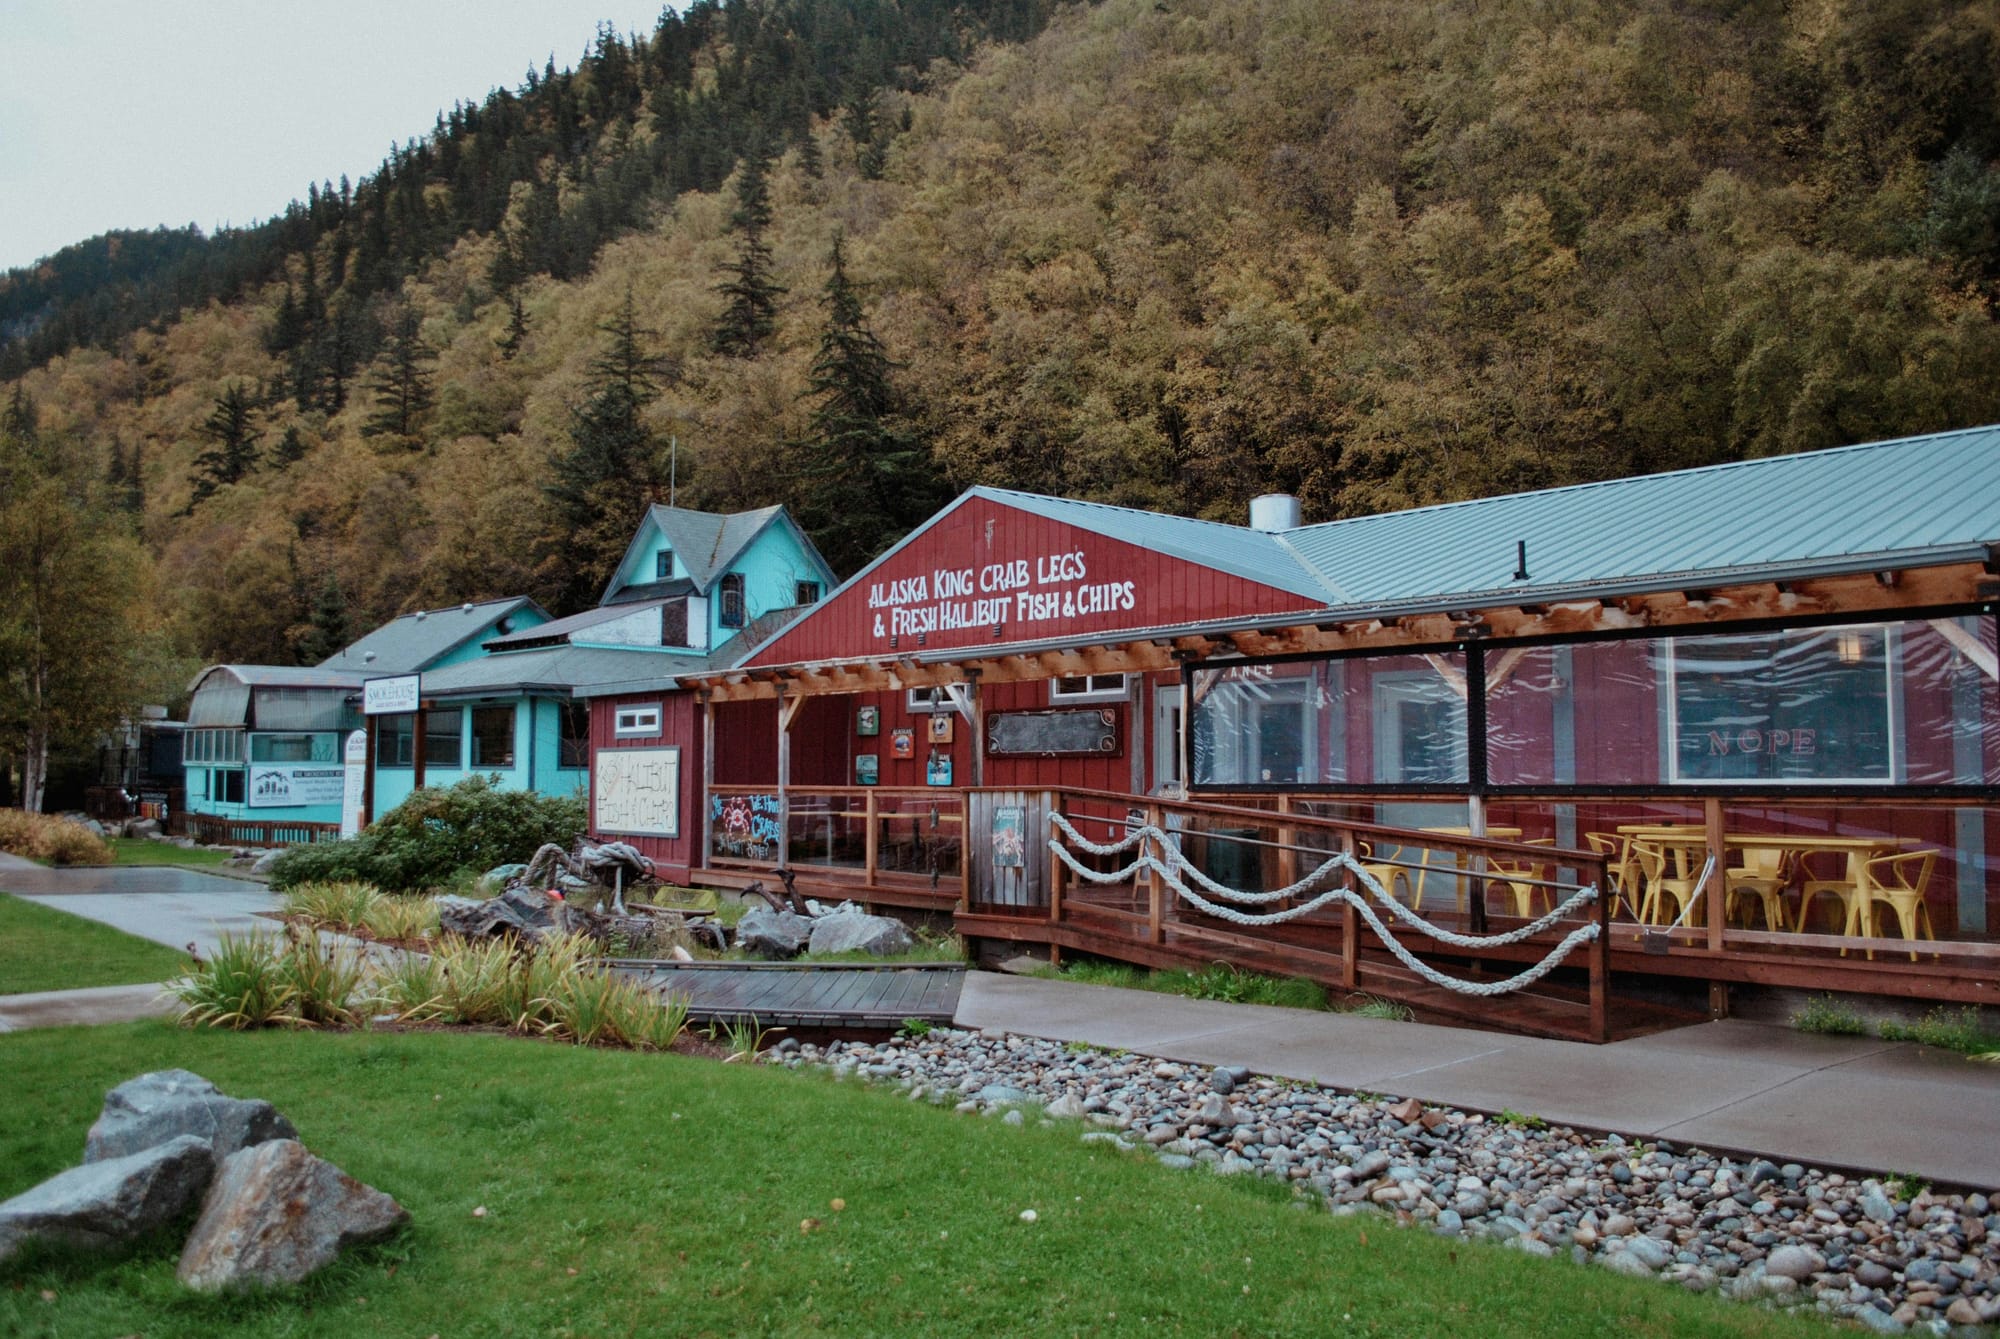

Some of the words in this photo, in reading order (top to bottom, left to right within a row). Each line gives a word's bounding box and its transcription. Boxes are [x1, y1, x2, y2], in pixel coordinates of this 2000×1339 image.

[869, 576, 927, 608] ALASKA
[934, 569, 973, 599] KING
[980, 559, 1030, 592] CRAB
[1037, 551, 1086, 584] LEGS
[873, 614, 885, 638] &
[892, 606, 937, 636] FRESH
[939, 597, 1012, 630] HALIBUT
[1017, 591, 1059, 622] FISH
[1062, 590, 1076, 618] &
[1077, 580, 1136, 616] CHIPS
[1708, 729, 1816, 756] NOPE
